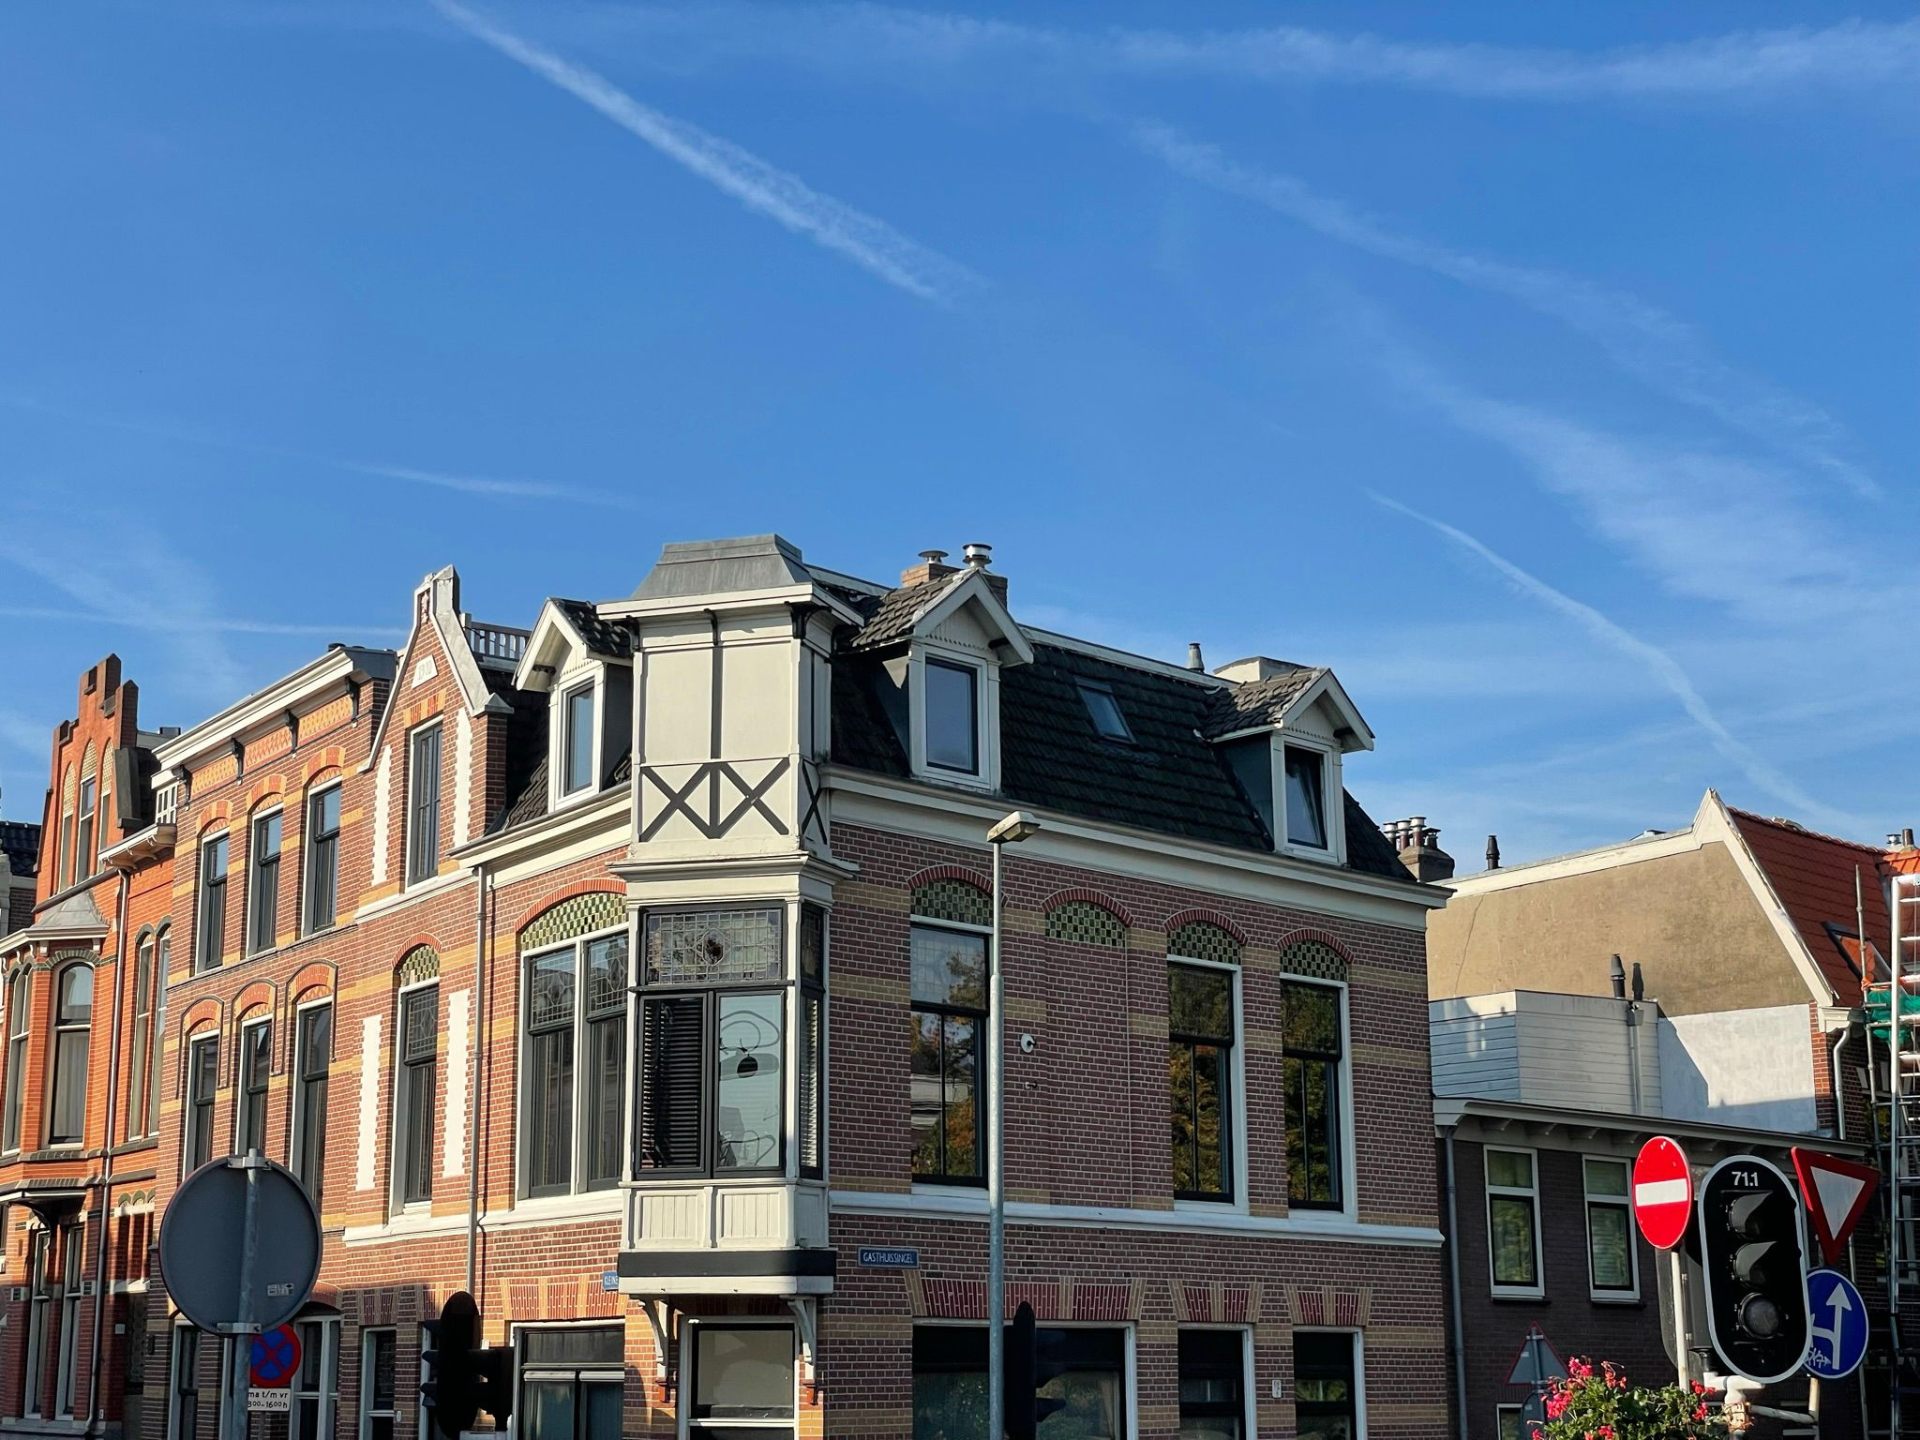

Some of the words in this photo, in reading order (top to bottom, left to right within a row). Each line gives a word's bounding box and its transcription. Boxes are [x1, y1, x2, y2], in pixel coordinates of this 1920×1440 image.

[1731, 1171, 1759, 1187] 71.1
[863, 1252, 914, 1264] GASTHUISSINGEL
[262, 1390, 278, 1398] t/m
